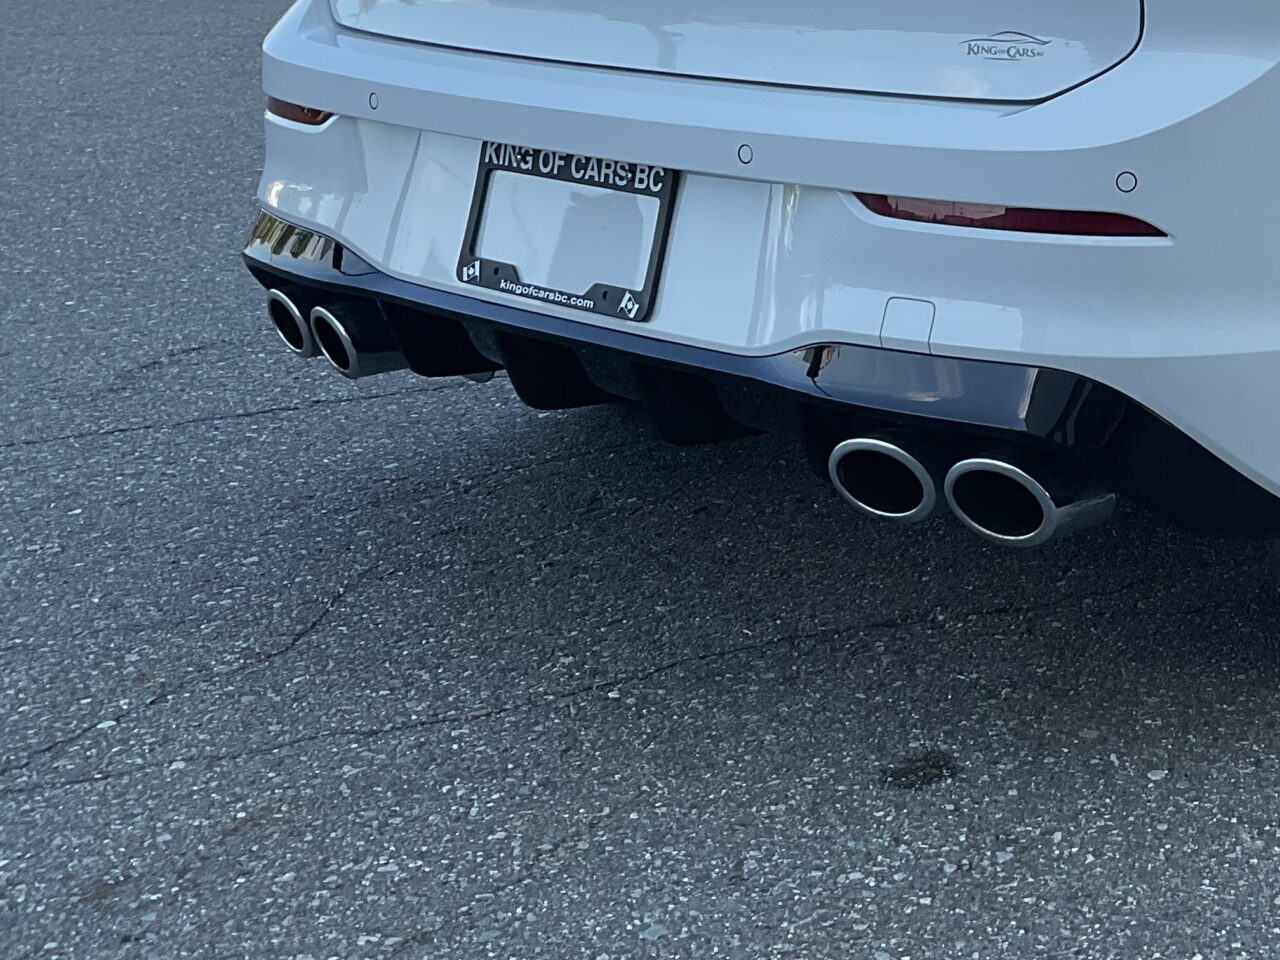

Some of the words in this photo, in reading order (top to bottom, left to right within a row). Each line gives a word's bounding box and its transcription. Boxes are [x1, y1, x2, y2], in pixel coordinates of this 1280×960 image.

[966, 43, 998, 56] KING
[1006, 45, 1037, 58] CARS
[484, 141, 534, 170] KING
[538, 150, 568, 175] OF
[571, 155, 630, 186] CARS
[634, 164, 665, 192] BC
[500, 278, 594, 309] kingofcarsbc.com
